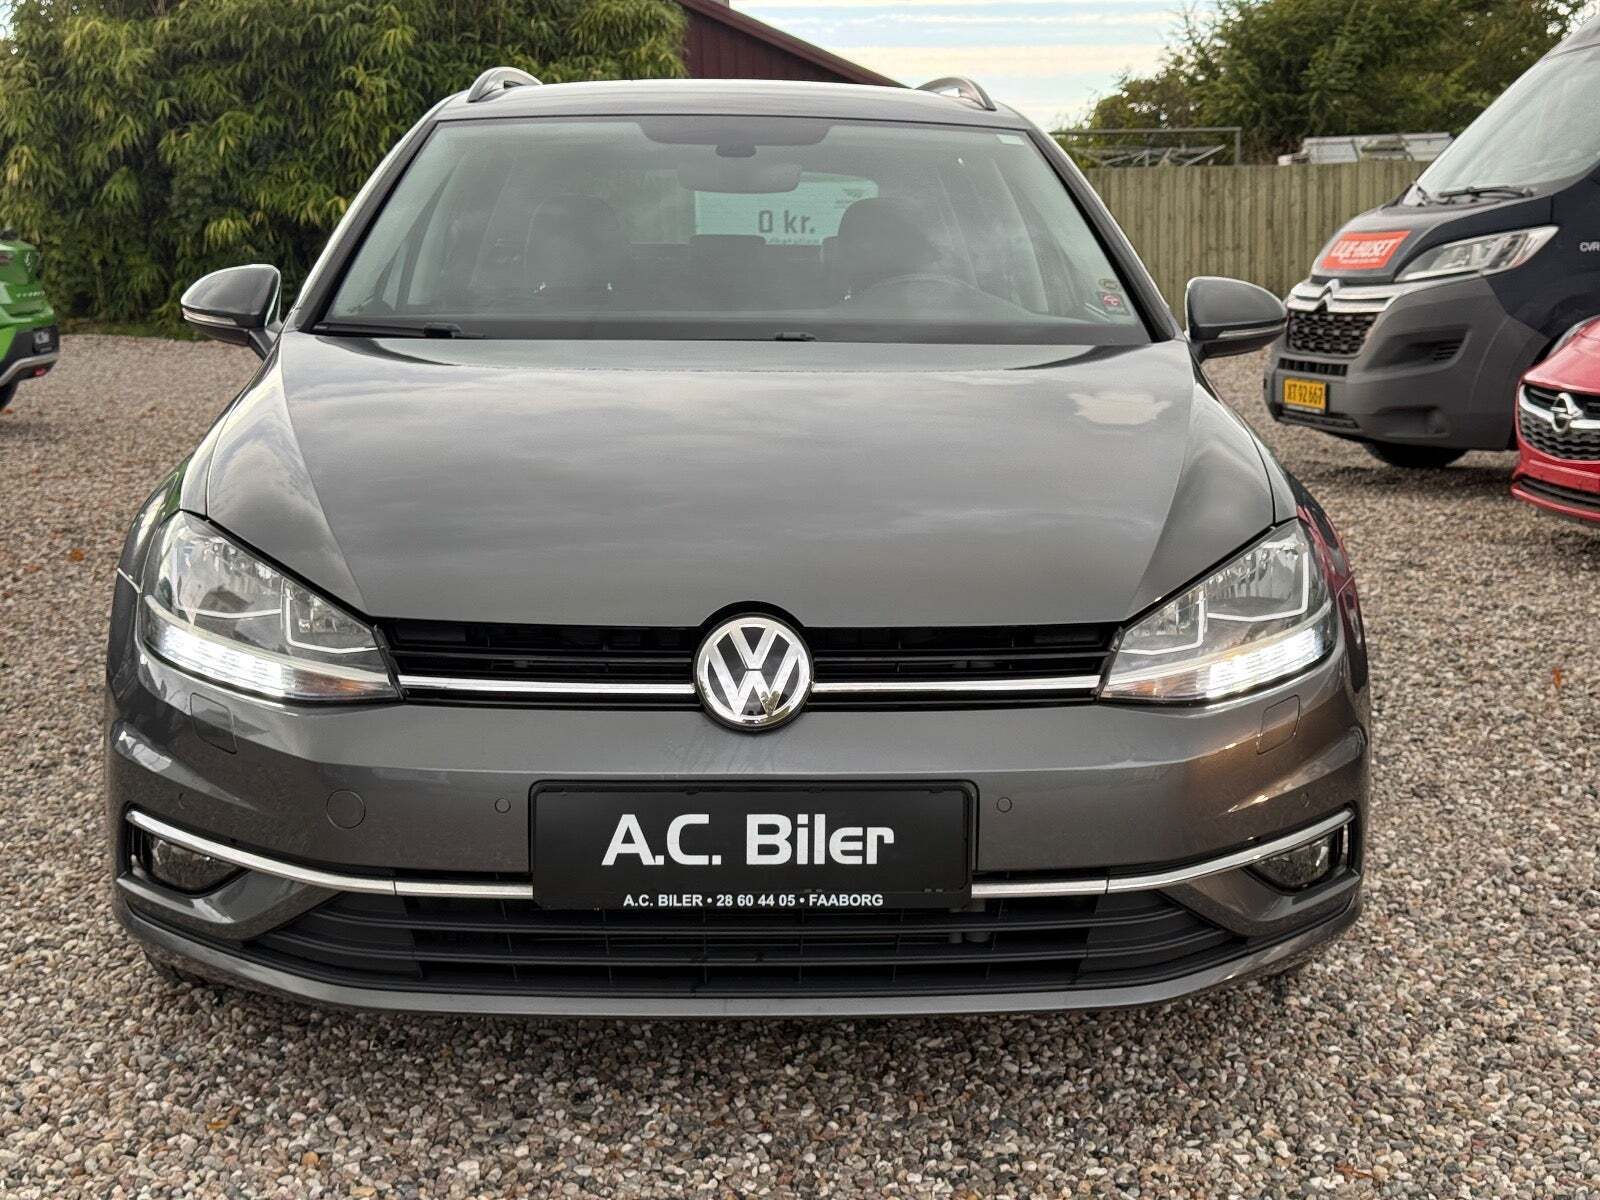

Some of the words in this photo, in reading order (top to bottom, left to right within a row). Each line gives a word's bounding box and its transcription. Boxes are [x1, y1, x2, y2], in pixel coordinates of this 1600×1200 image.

[758, 210, 773, 234] 0
[785, 210, 815, 234] kr.
[699, 617, 810, 724] VW
[601, 813, 722, 866] A.C.
[746, 813, 895, 866] Biler
[623, 894, 653, 907] A.C.
[657, 894, 703, 907] BILER
[716, 894, 733, 907] 28
[736, 894, 753, 907] 60
[757, 894, 775, 907] 44
[778, 894, 796, 907] 05
[808, 894, 884, 907] FAABORG
